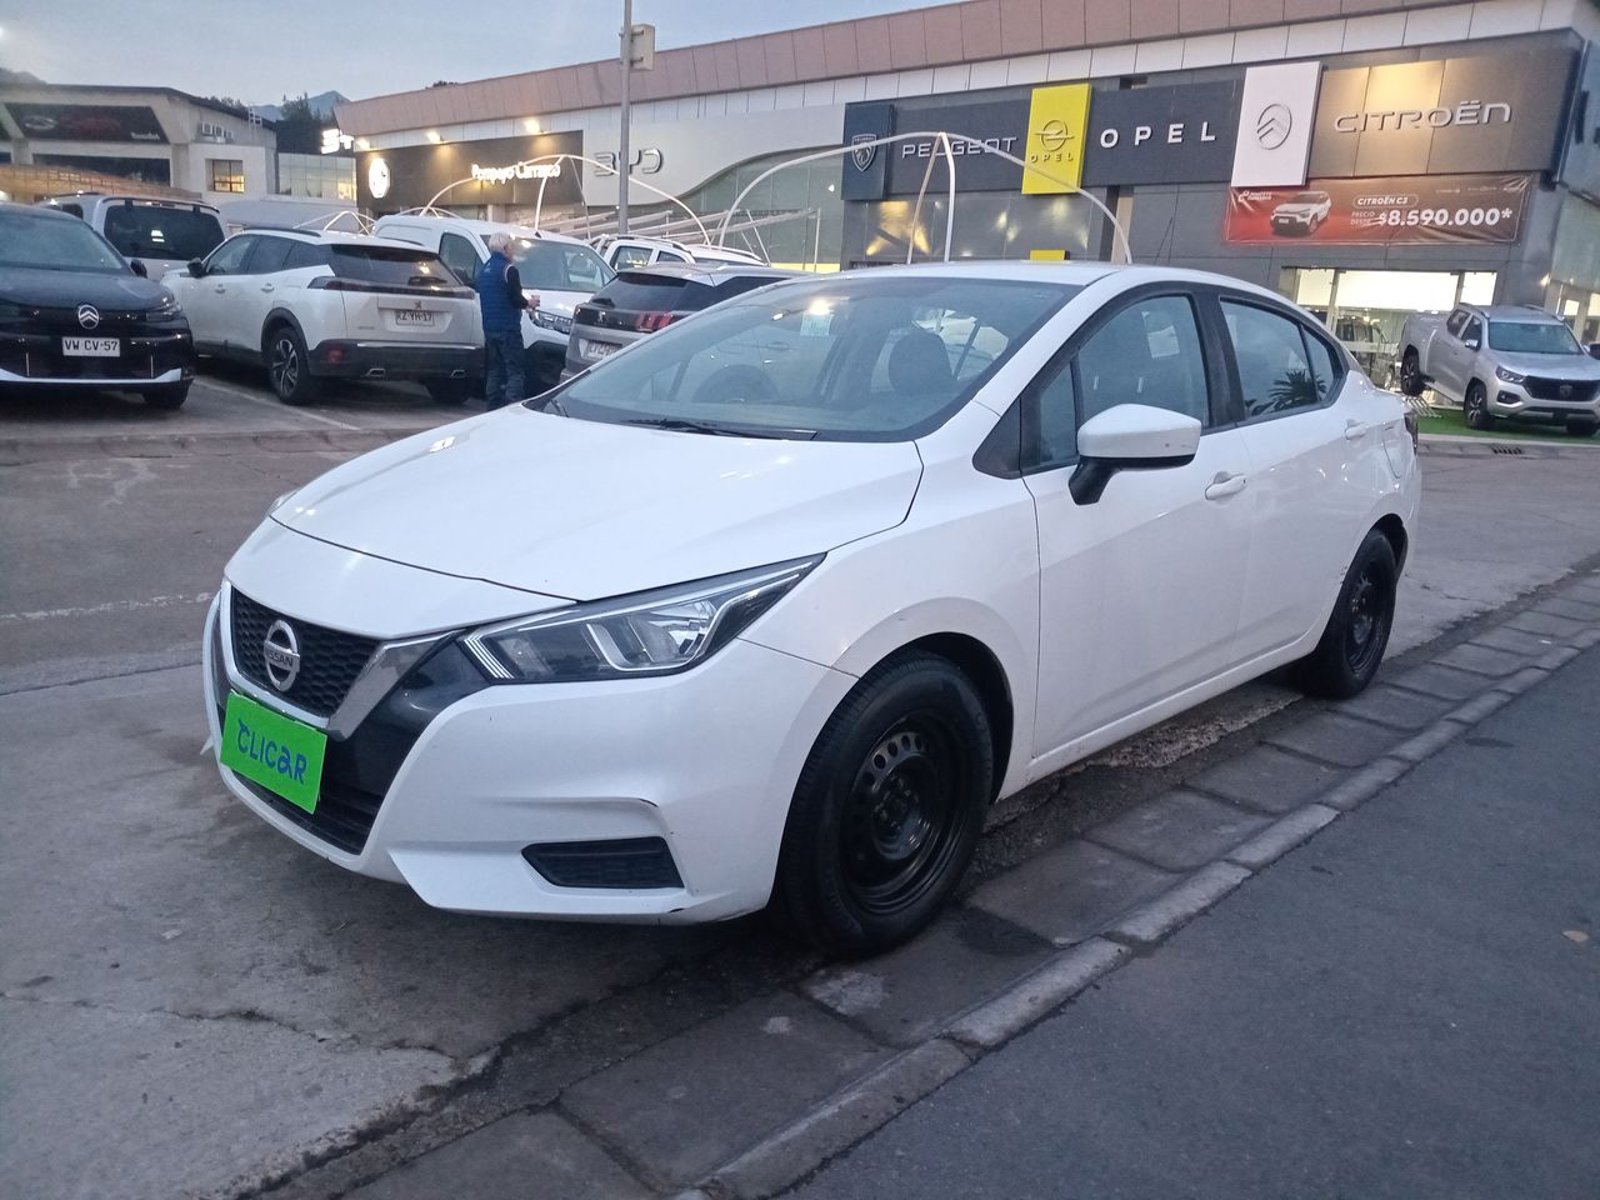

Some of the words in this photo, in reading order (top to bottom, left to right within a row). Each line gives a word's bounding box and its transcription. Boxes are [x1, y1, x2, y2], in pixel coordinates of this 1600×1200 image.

[1334, 99, 1512, 134] CITROËN
[1100, 121, 1216, 149] OPEL
[1030, 152, 1075, 163] OPEL
[64, 339, 80, 351] VW
